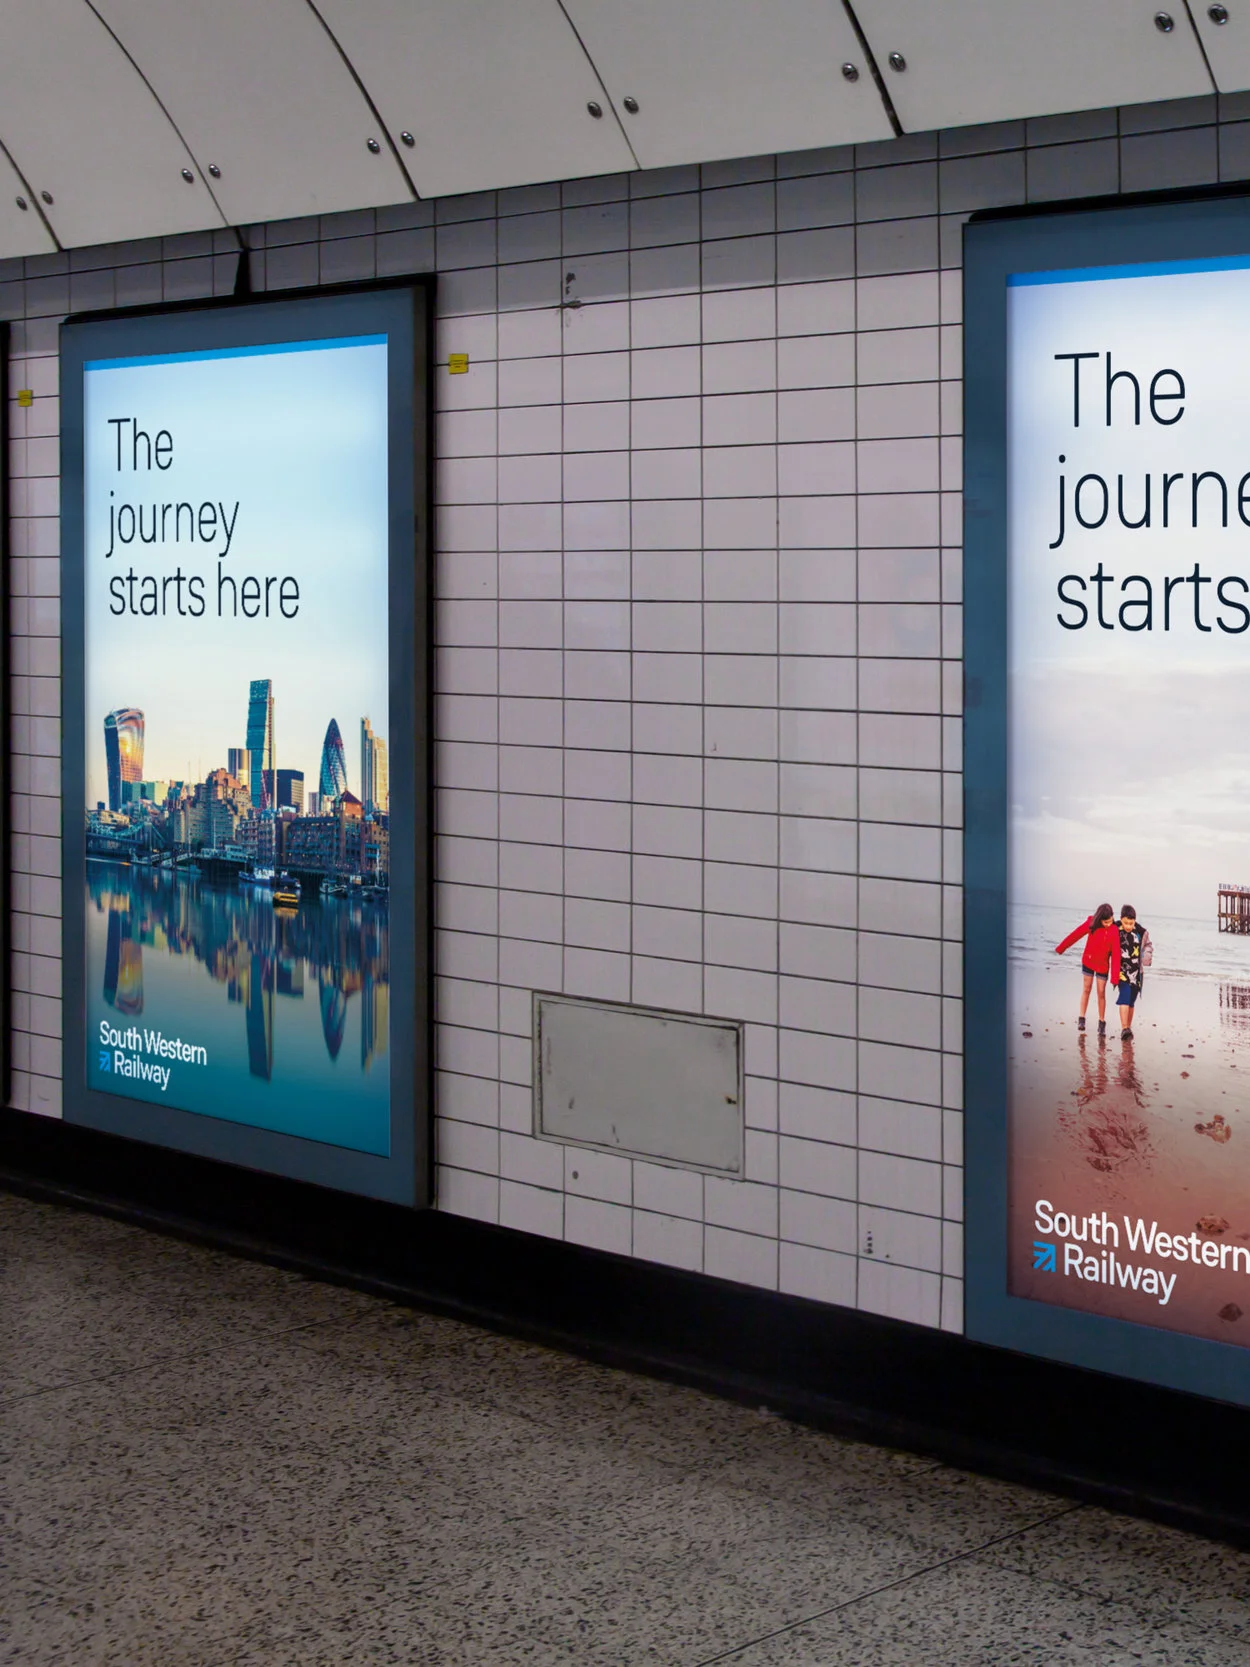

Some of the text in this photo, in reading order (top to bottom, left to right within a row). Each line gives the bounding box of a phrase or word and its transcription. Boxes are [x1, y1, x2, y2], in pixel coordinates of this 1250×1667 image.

[1053, 351, 1186, 428] The
[107, 417, 173, 472] The
[105, 490, 240, 559] journey
[109, 561, 300, 619] starts here
[1056, 562, 1250, 634] starts
[99, 1020, 207, 1066] South Western
[114, 1050, 171, 1091] Railway
[1034, 1199, 1250, 1274] South Western
[1064, 1242, 1177, 1306] Railway
